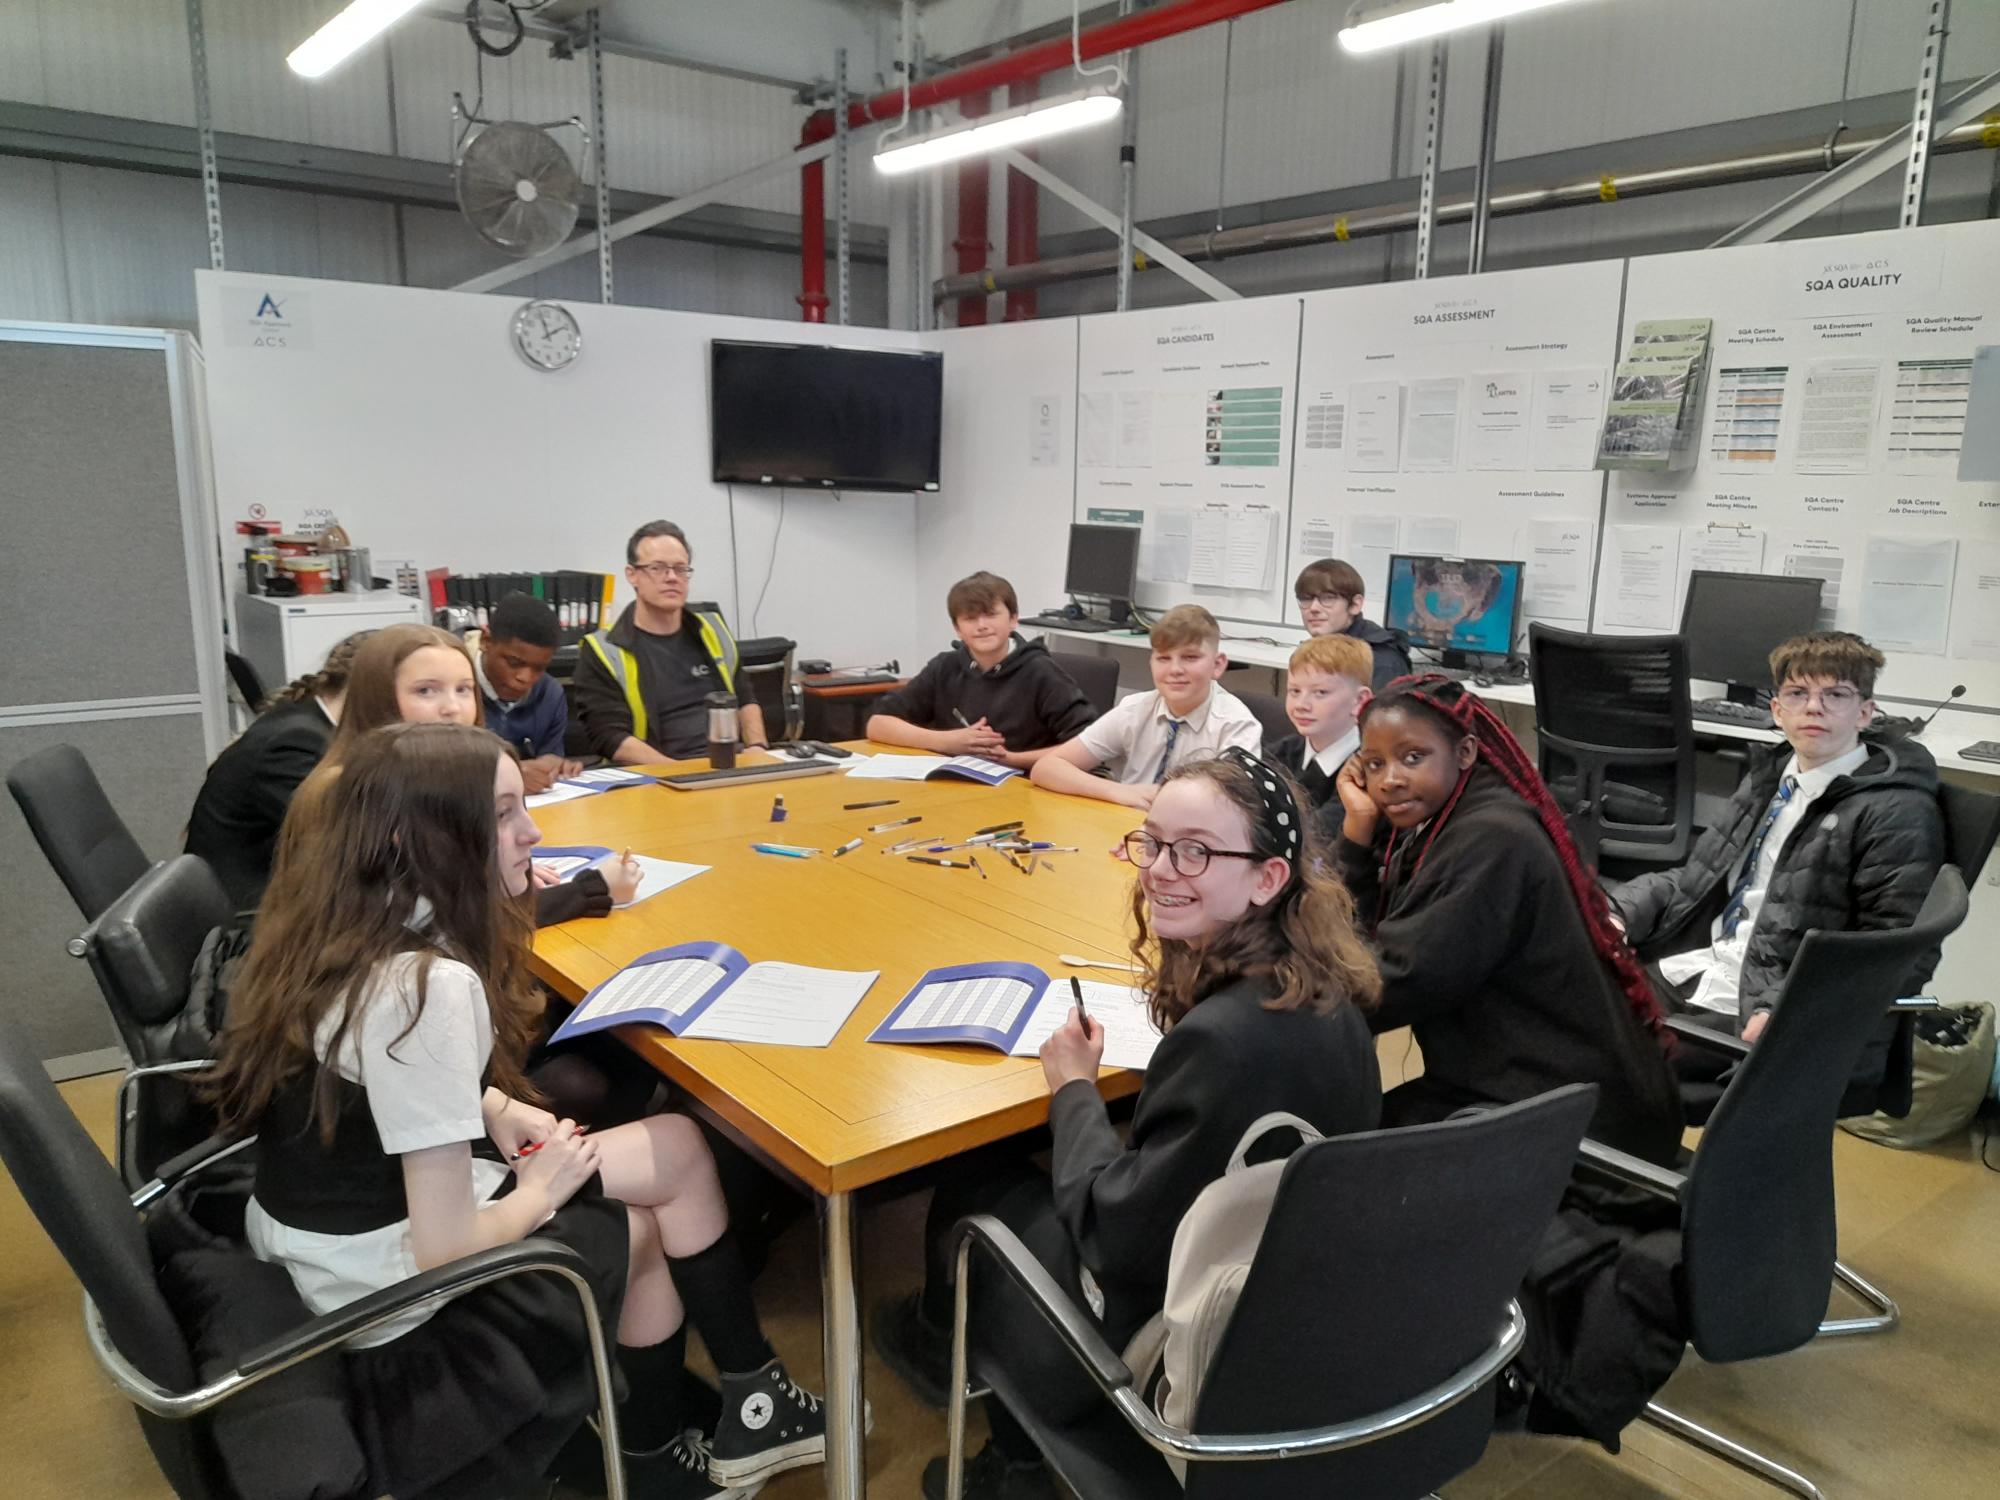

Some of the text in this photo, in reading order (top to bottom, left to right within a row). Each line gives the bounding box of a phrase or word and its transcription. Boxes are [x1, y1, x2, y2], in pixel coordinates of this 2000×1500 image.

[1805, 273, 1902, 292] SQA QUALITY
[1413, 309, 1496, 325] SQA ASSESSMENT
[1924, 316, 1951, 324] Quality
[1829, 322, 1872, 330] Environment
[1171, 333, 1215, 344] CANDIDATES
[1821, 331, 1862, 339] Assessment
[1541, 343, 1568, 351] Strategy
[1706, 502, 1731, 510] Meeting
[1902, 507, 1948, 516] Descriptions
